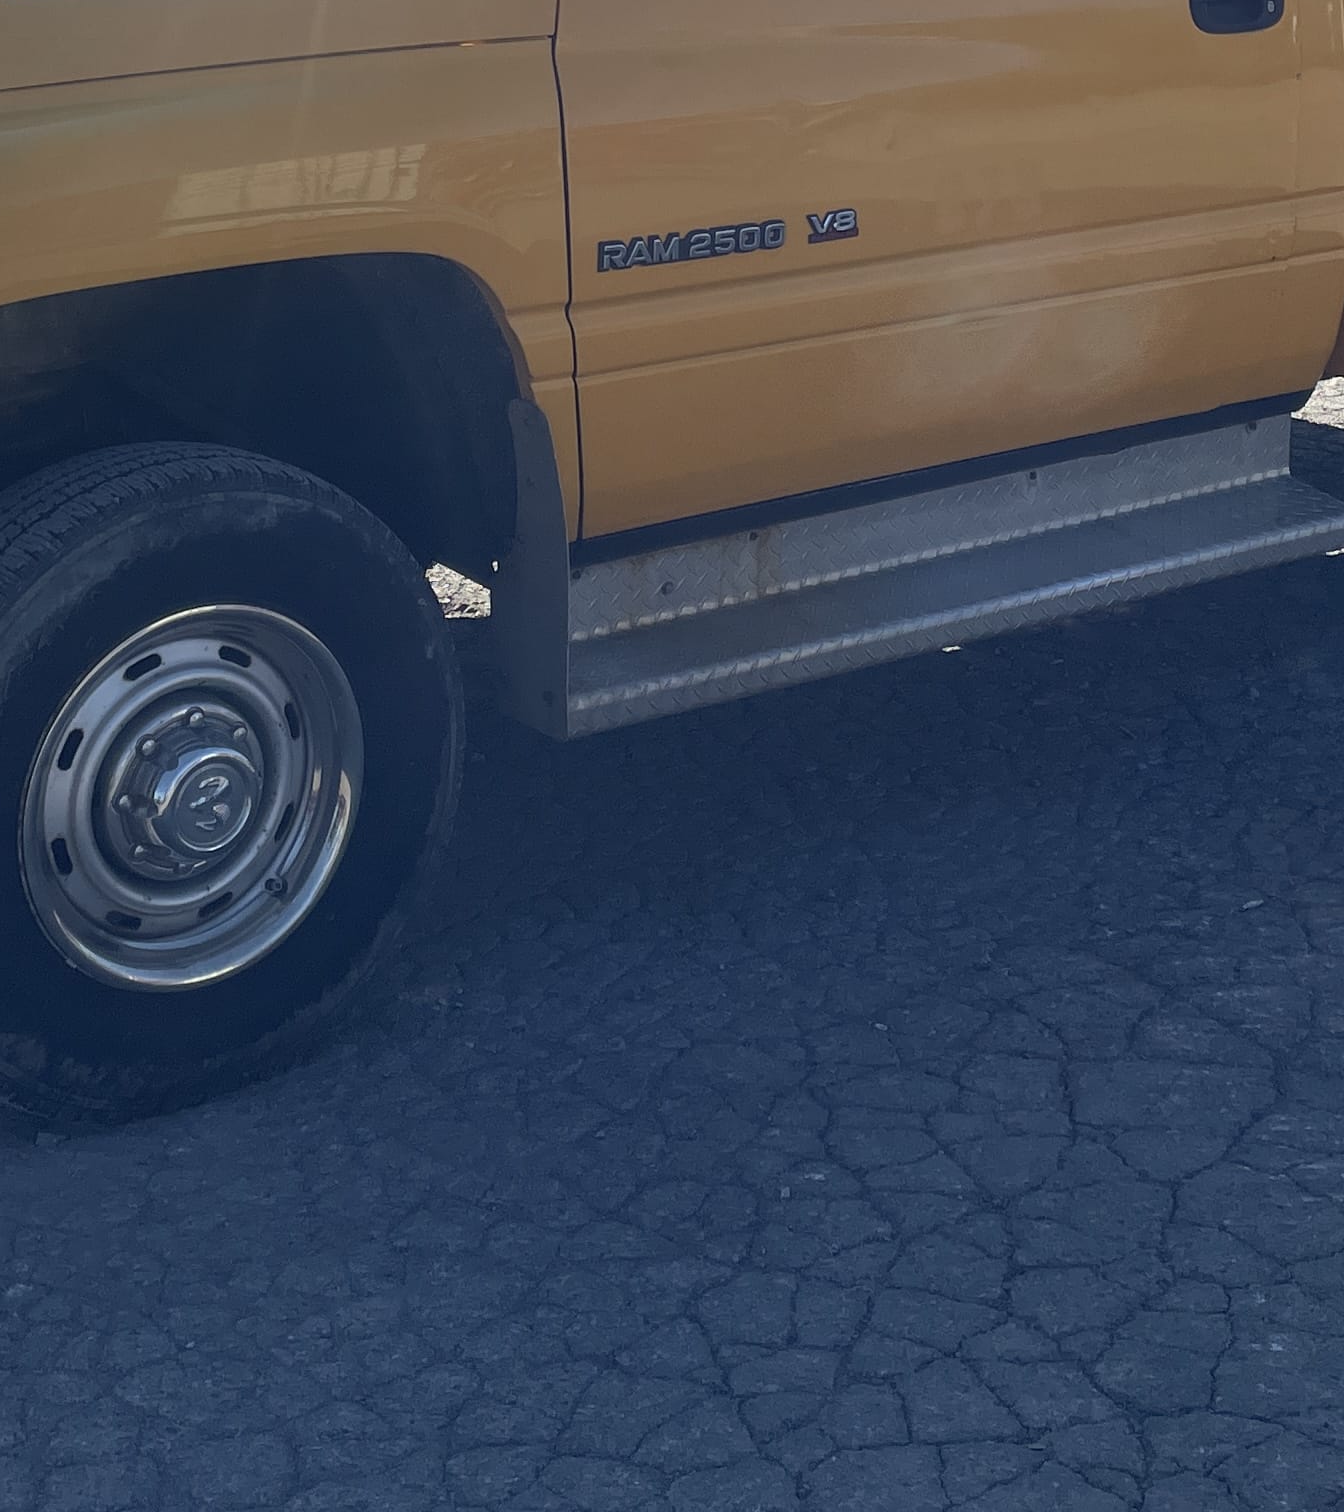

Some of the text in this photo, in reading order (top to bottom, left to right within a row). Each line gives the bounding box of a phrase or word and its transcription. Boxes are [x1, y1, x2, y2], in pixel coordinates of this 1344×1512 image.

[598, 208, 857, 272] RAM 2500 V8
